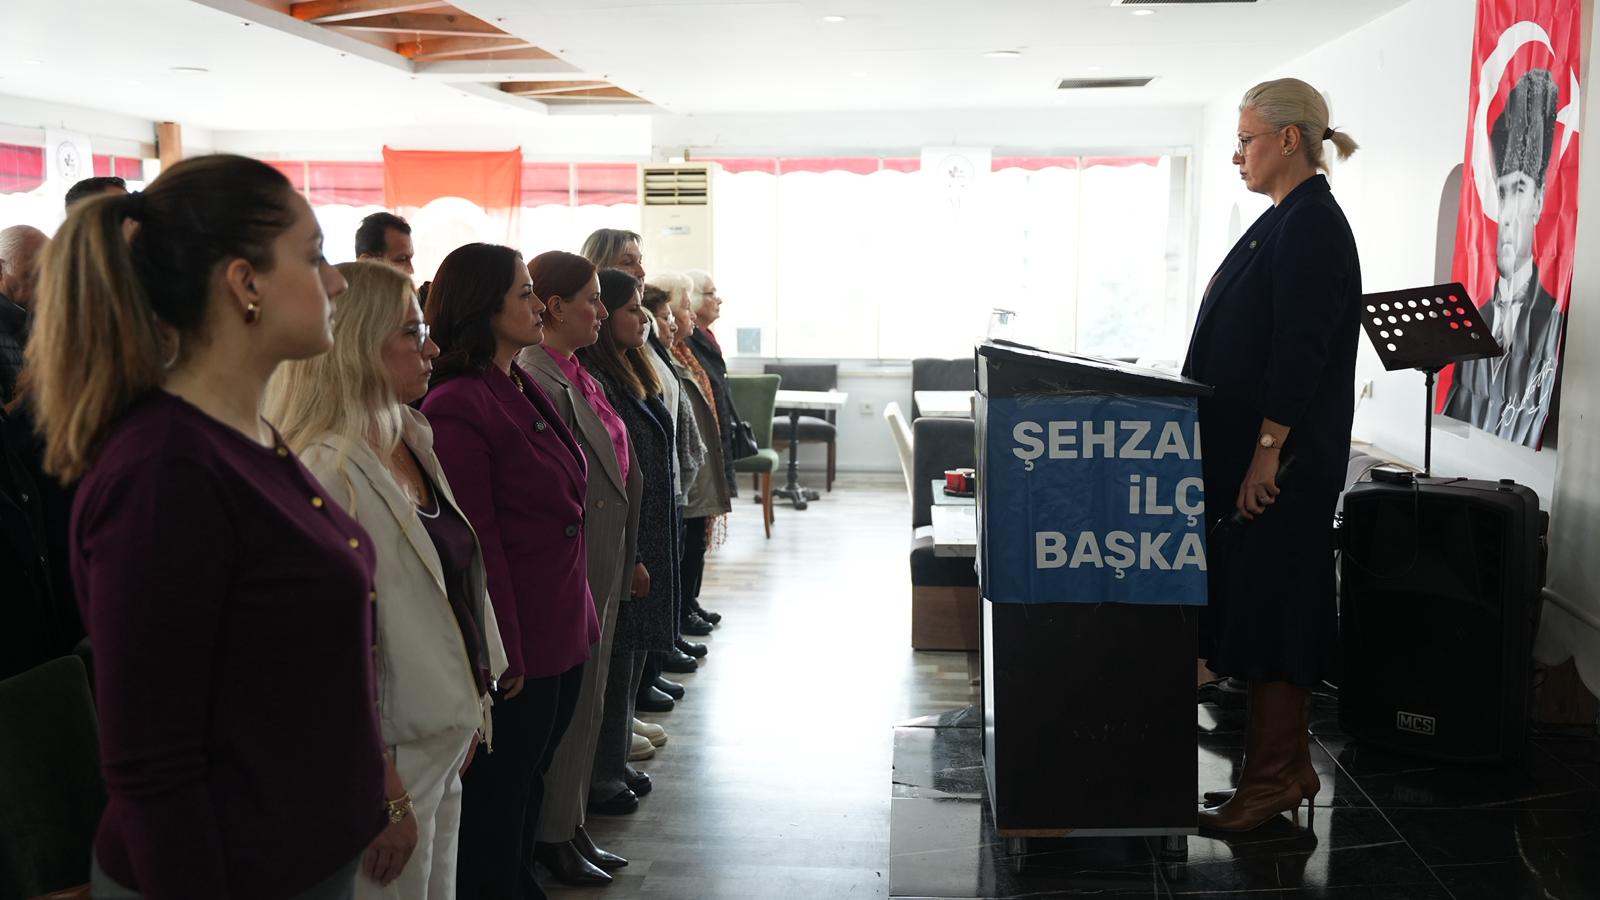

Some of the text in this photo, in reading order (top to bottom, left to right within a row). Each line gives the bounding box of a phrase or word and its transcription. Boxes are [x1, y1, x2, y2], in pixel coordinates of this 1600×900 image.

[1012, 420, 1202, 472] ŞEHZA
[1035, 530, 1208, 579] BAŞKA
[1400, 714, 1432, 732] MCS
